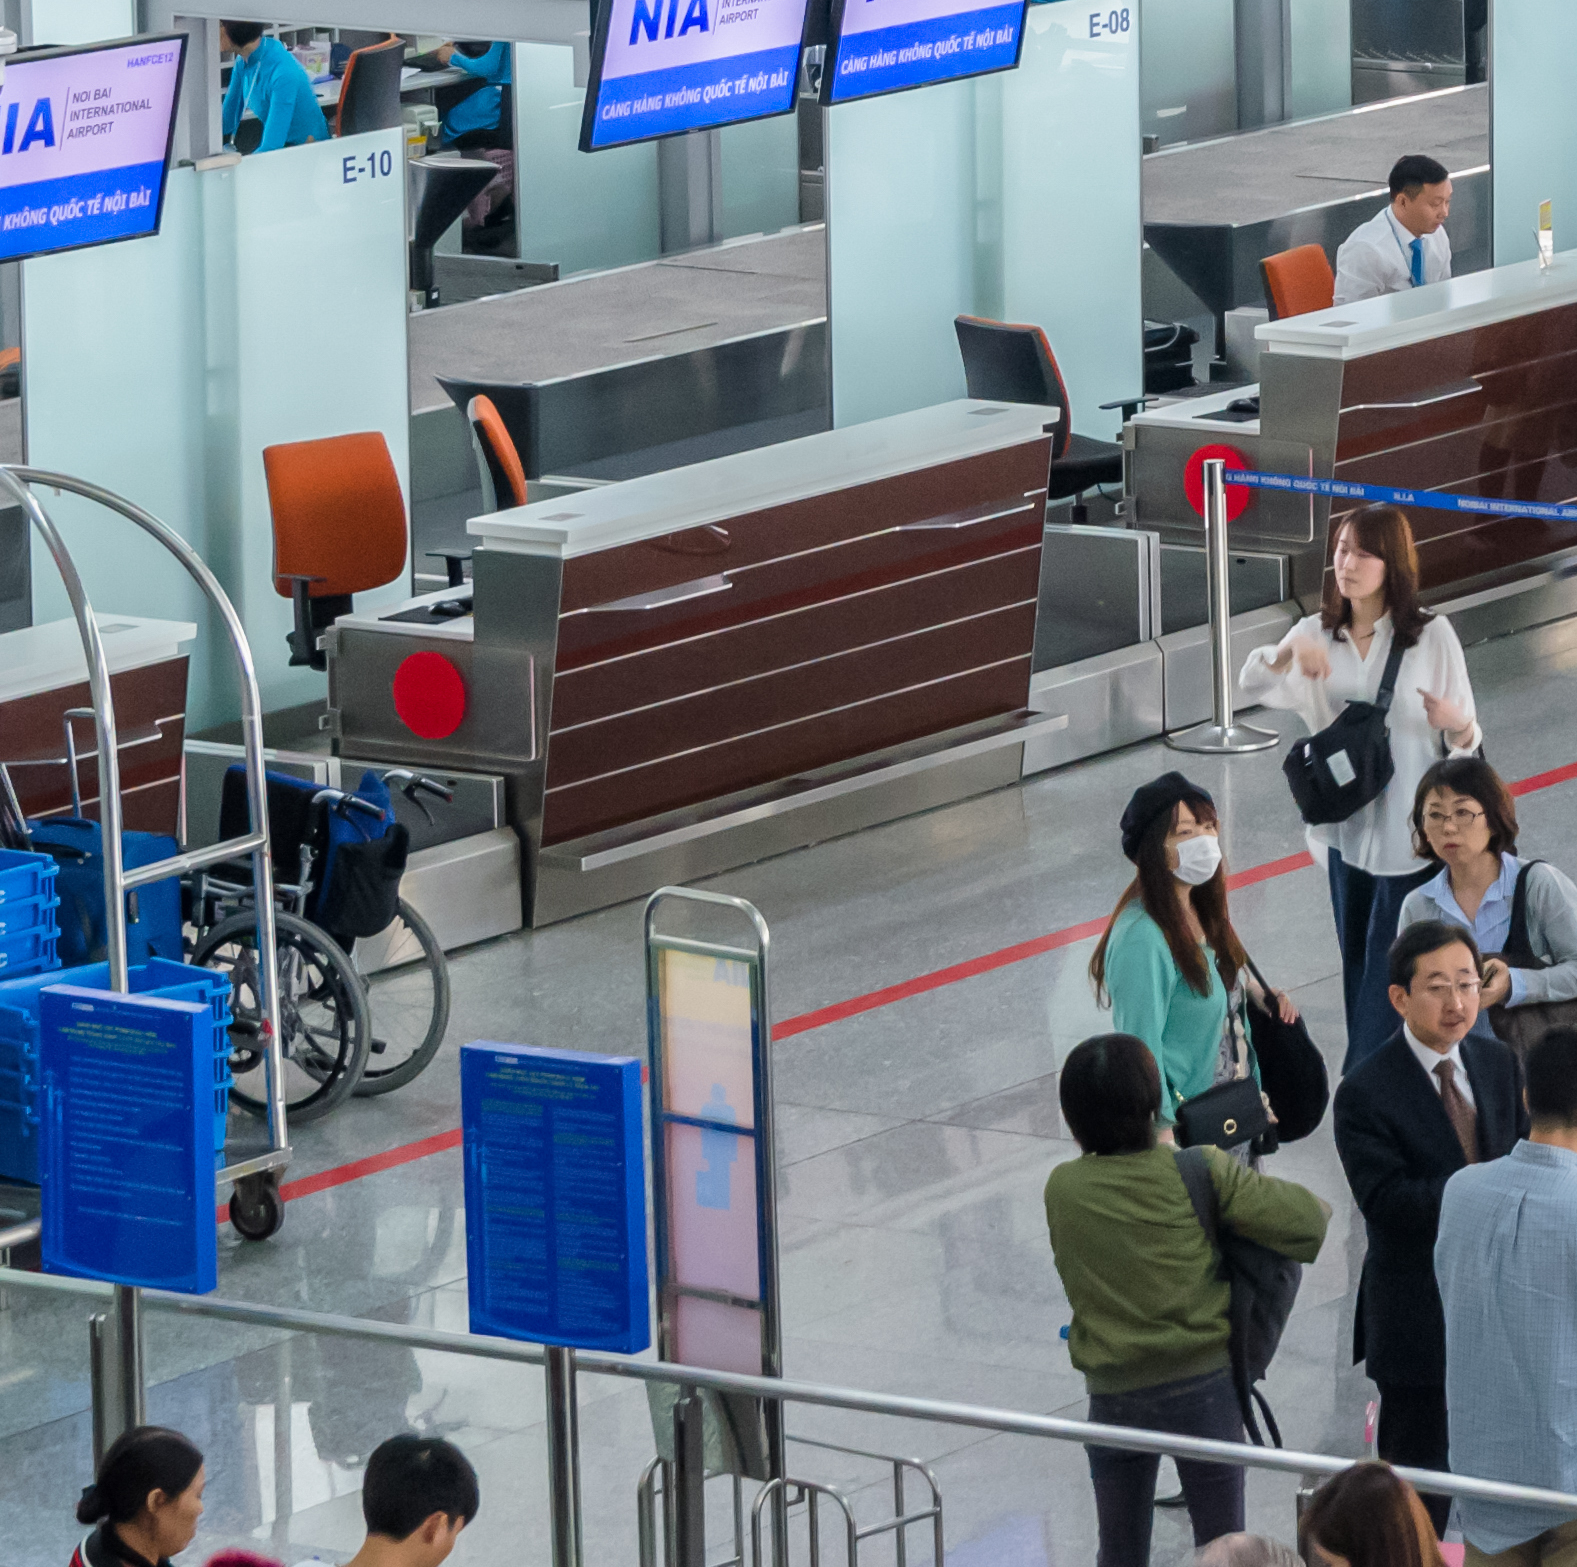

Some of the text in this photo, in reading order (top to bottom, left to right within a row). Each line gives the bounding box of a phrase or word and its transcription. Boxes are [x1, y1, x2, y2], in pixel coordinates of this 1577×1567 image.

[719, 9, 759, 26] AIRPORT
[1089, 7, 1130, 39] E-08
[869, 48, 896, 69] HÀNG
[898, 43, 932, 64] KHÔNG
[934, 35, 961, 60] QUỐC
[963, 31, 977, 50] TẾ
[975, 28, 993, 53] NỘI
[72, 87, 112, 103] NOI BAI
[633, 92, 662, 115] HÀNG
[664, 85, 701, 109] KHÔNG
[703, 77, 733, 104] QUỐC
[735, 74, 748, 94] TẾ
[748, 71, 769, 96] NỘI
[770, 67, 789, 88] BÀI
[70, 99, 153, 122] INTERNATIONAL
[66, 121, 114, 139] AIRPORT
[342, 149, 392, 184] E-10
[3, 186, 151, 231] KHÔNG QUỐC TẾ NỘI BÀI
